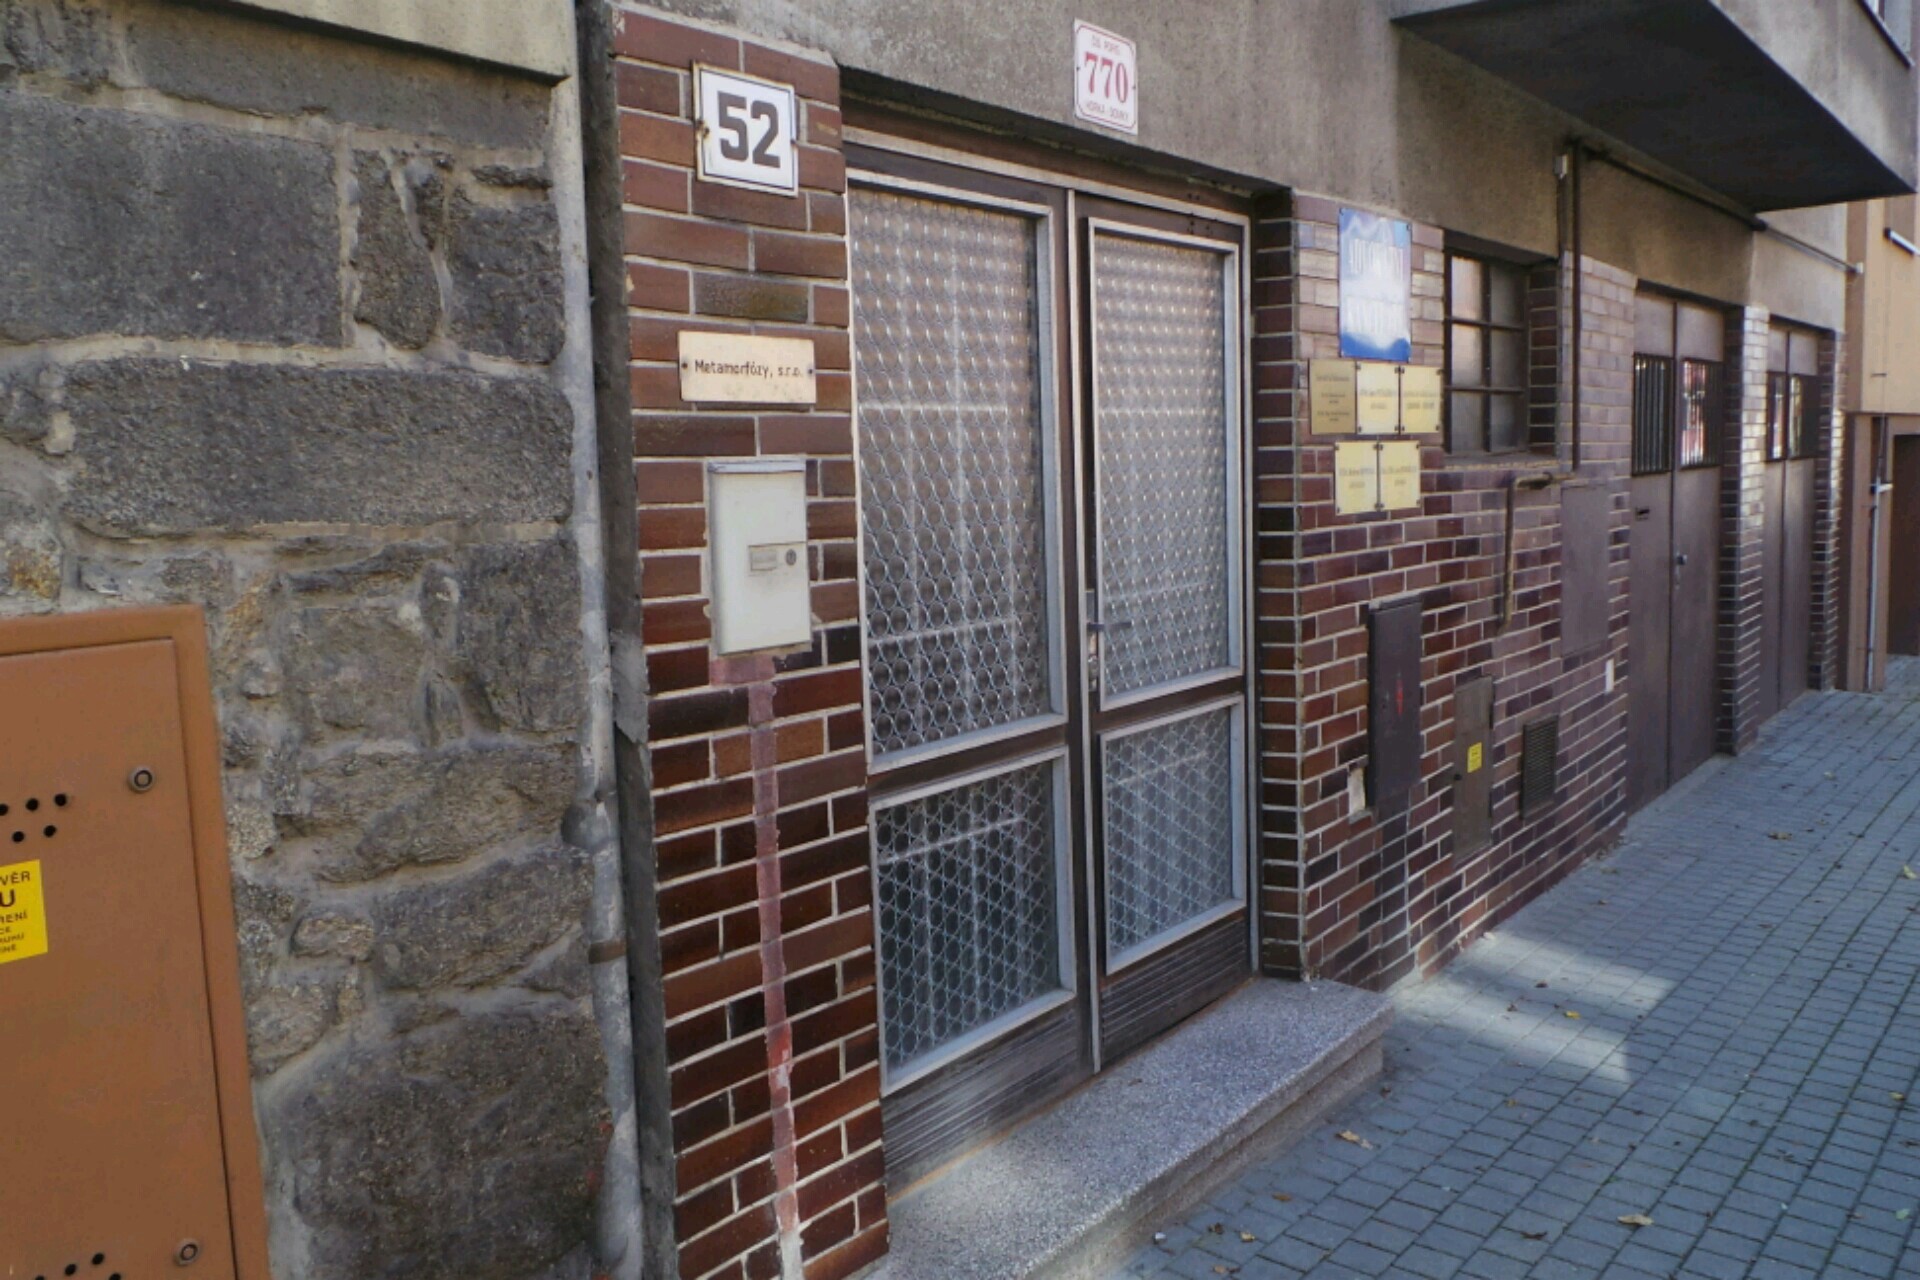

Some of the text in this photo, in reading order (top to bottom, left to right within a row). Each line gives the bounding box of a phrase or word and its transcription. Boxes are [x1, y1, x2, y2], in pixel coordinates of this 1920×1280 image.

[1084, 52, 1129, 103] 770
[717, 91, 781, 169] 52
[694, 359, 773, 379] Metamorfózy,
